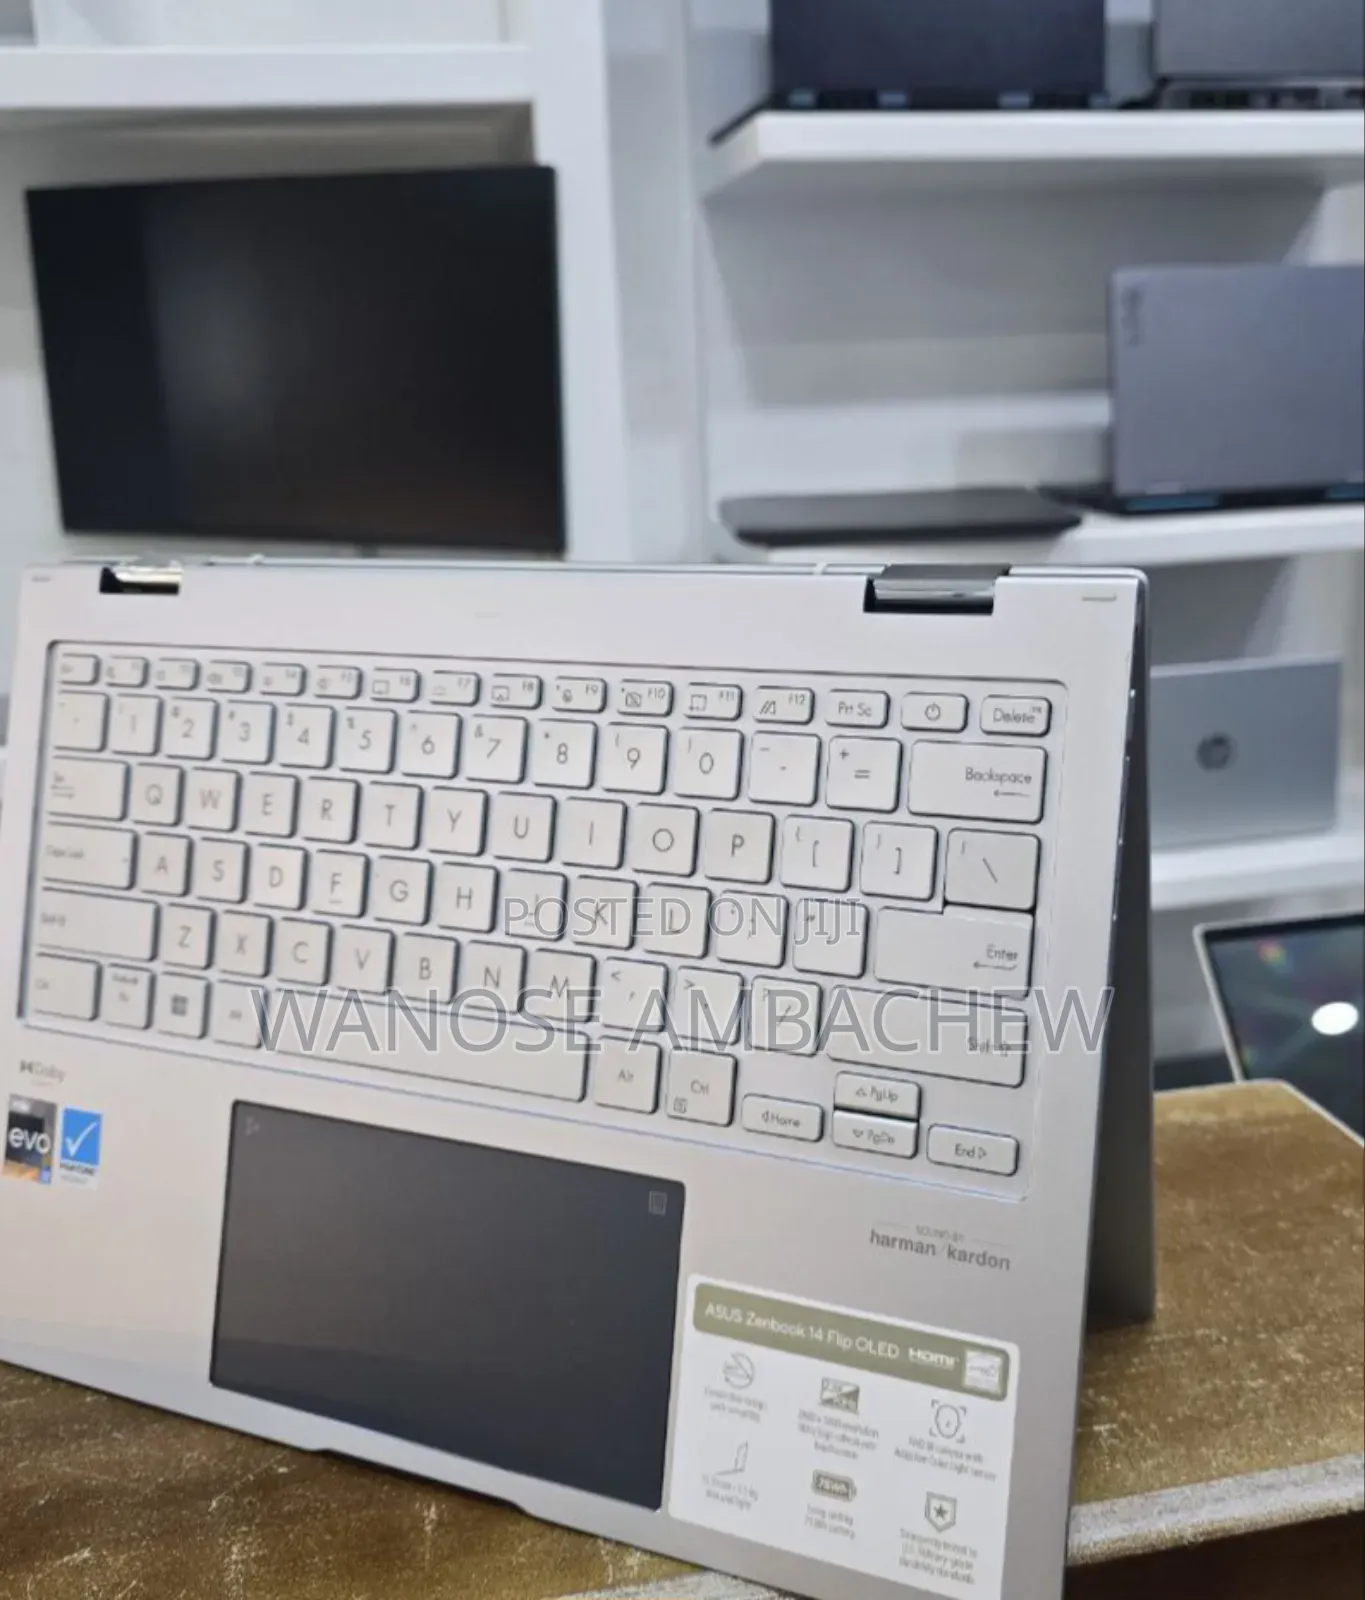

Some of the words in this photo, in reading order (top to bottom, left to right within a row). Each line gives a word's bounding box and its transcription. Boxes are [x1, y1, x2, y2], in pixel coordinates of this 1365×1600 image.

[586, 685, 599, 696] F9
[648, 687, 666, 700] F10
[788, 693, 806, 706] F12
[993, 707, 1036, 725] Delete
[182, 717, 195, 740] 2
[239, 721, 251, 743] 3
[298, 726, 310, 746] 4
[359, 730, 373, 750] 5
[421, 735, 436, 756] 6
[486, 738, 502, 759] 7
[556, 742, 569, 765] 8
[626, 746, 641, 771] 9
[965, 766, 1033, 786] Backspace
[145, 783, 164, 806] Q
[200, 788, 221, 811] W
[261, 792, 274, 817] E
[320, 798, 334, 822] R
[384, 803, 397, 828] T
[447, 808, 462, 833] Y
[513, 815, 530, 840] U
[652, 828, 675, 853] O
[730, 834, 746, 858] P
[155, 855, 169, 876] A
[213, 859, 227, 883] S
[268, 865, 284, 889] D
[330, 871, 343, 896] F
[389, 878, 410, 902] G
[456, 886, 473, 911] H
[178, 925, 193, 949] Z
[235, 934, 248, 956] X
[293, 940, 310, 964] C
[355, 948, 371, 971] V
[986, 946, 1019, 961] Enter
[418, 956, 433, 981] B
[484, 965, 501, 989] N
[550, 973, 570, 1000] M
[770, 1114, 801, 1129] Home
[9, 1127, 51, 1154] evo
[955, 1143, 977, 1159] End
[869, 1228, 937, 1257] harman
[946, 1243, 1012, 1271] kardon
[705, 1300, 743, 1325] ASUS
[745, 1309, 807, 1338] Zenbook
[808, 1325, 824, 1343] 14
[827, 1327, 853, 1352] Flip
[855, 1336, 900, 1360] OLED
